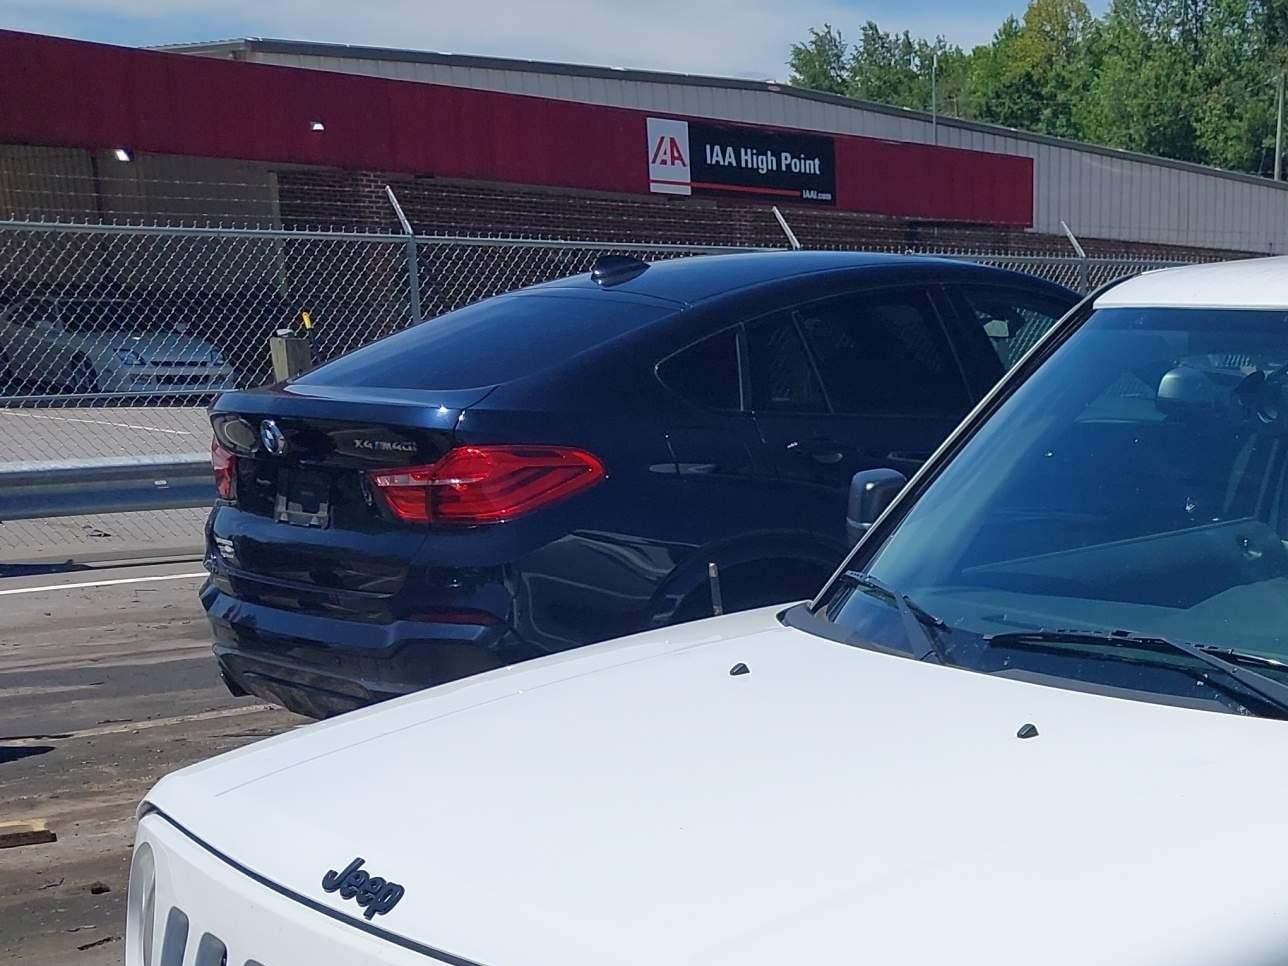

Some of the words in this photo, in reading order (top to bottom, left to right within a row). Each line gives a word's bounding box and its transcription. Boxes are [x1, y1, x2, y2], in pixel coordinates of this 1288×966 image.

[706, 144, 736, 167] IAA
[741, 148, 776, 174] High
[782, 152, 820, 175] Point
[322, 857, 405, 920] Jeep
